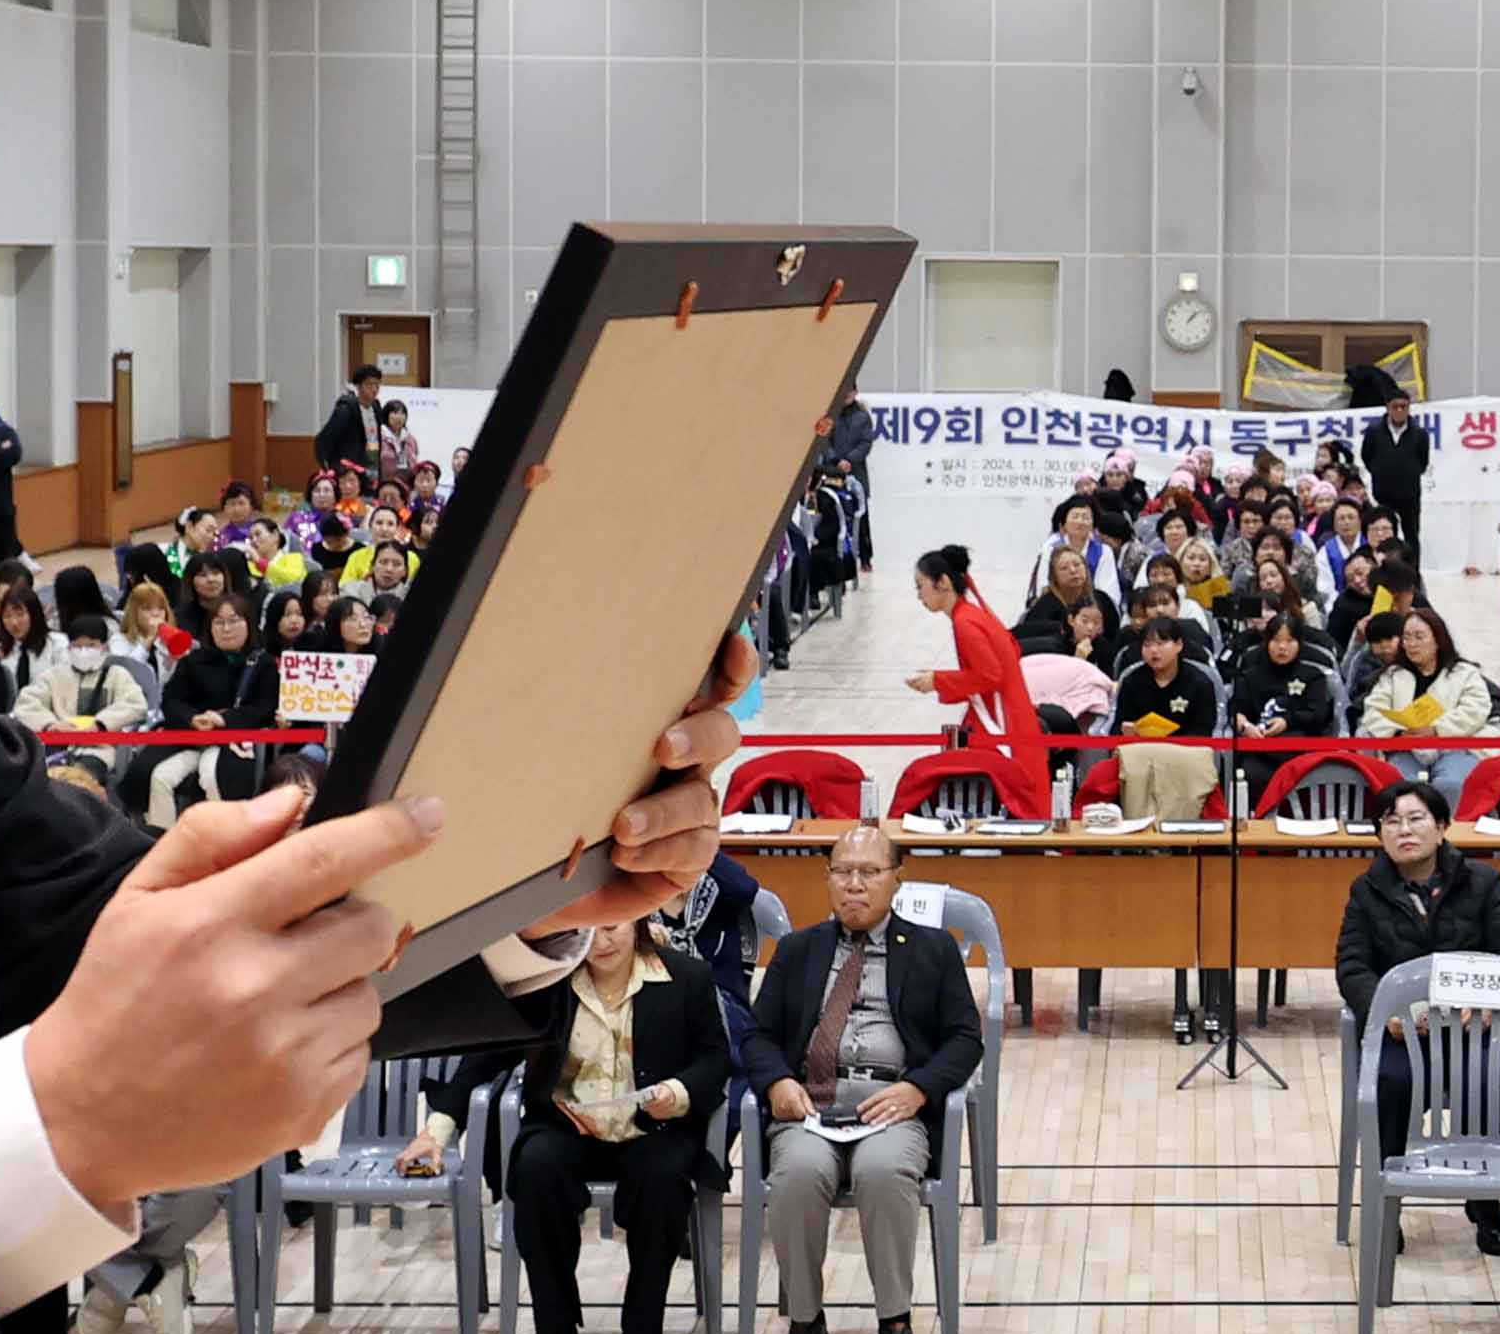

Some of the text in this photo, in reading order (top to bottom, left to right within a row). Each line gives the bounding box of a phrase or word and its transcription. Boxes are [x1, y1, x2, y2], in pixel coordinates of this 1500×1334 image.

[872, 406, 983, 445] 제9회
[1001, 407, 1213, 453] 인천광역시
[284, 655, 336, 683] 만석초
